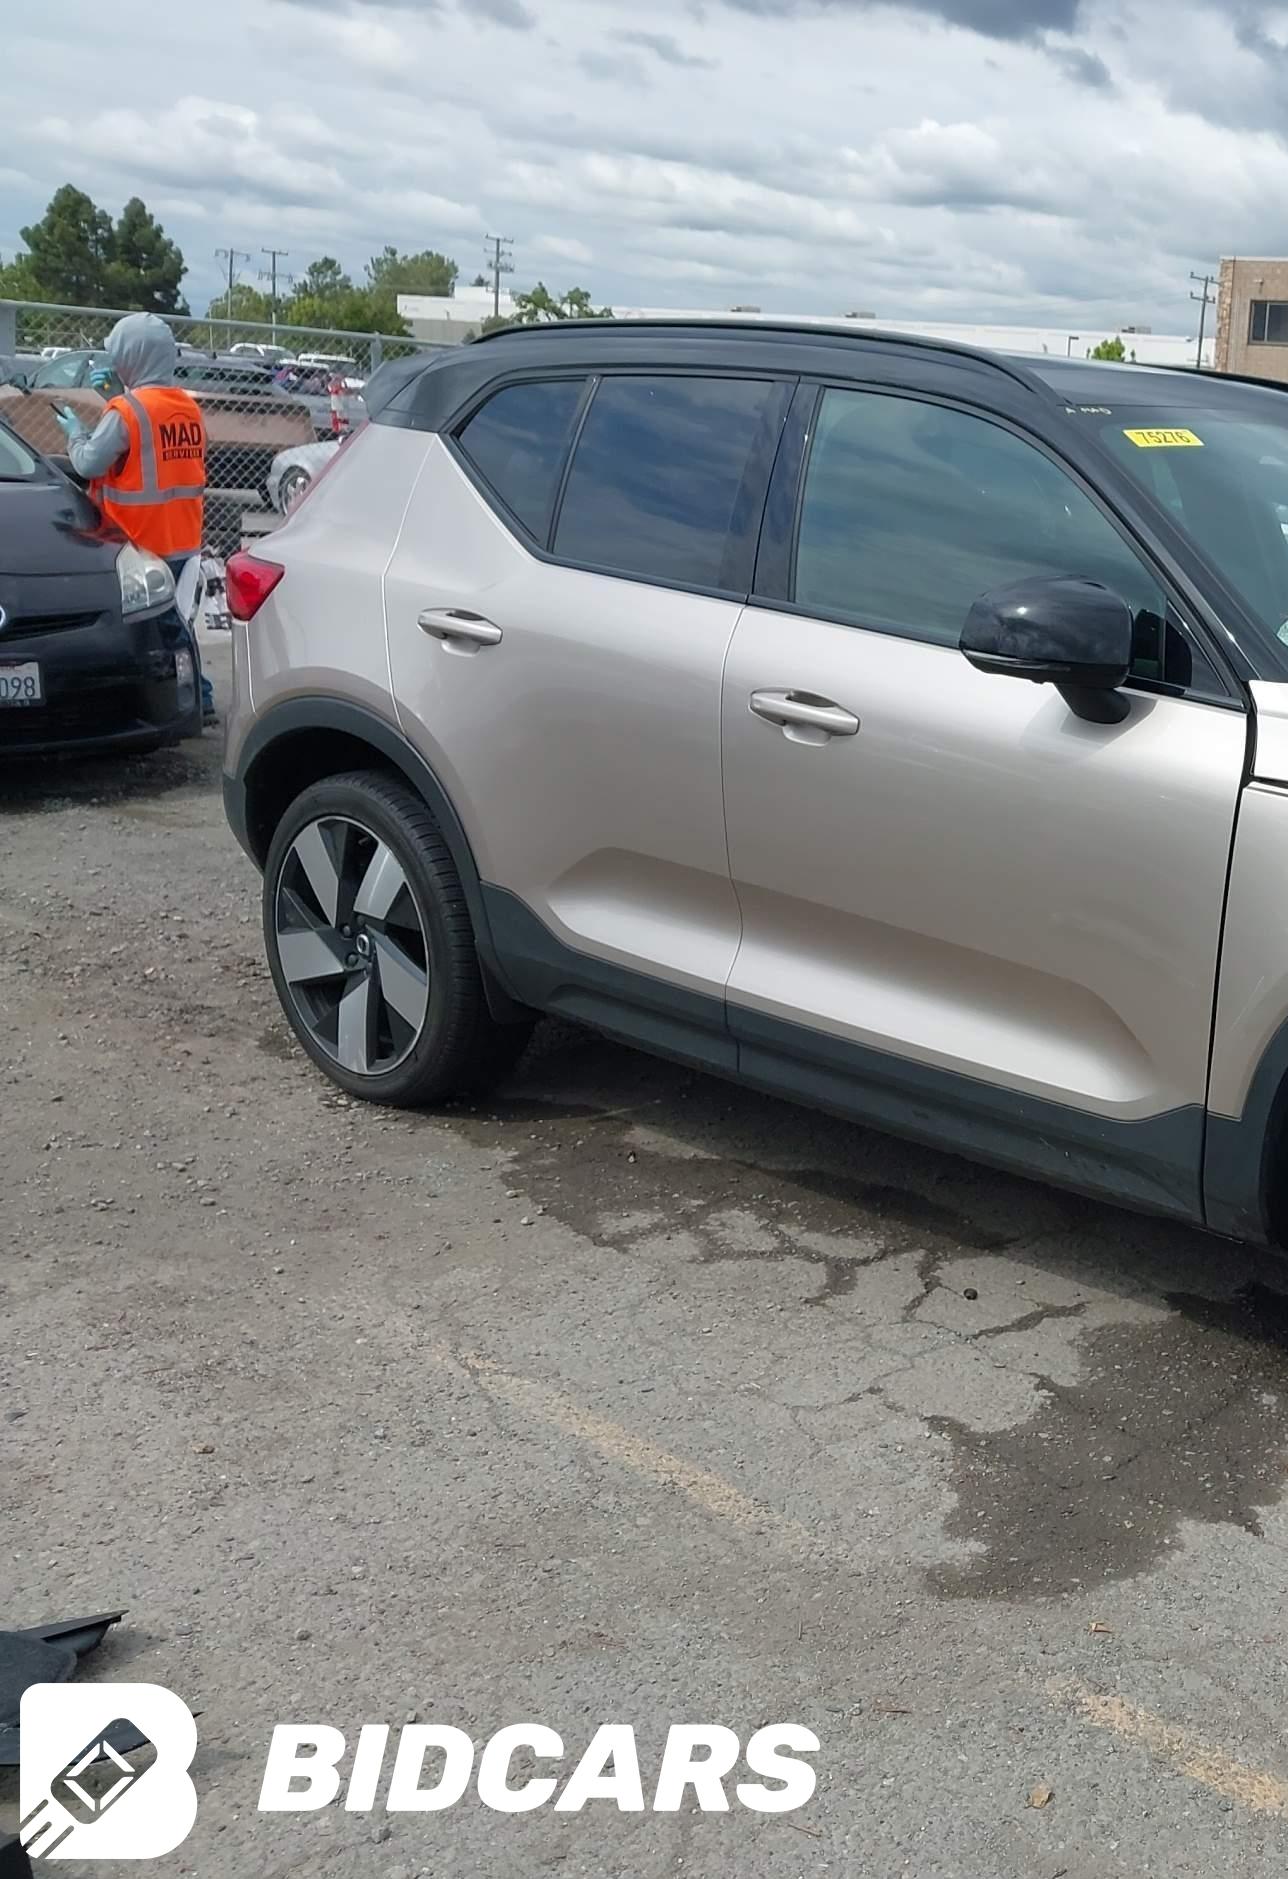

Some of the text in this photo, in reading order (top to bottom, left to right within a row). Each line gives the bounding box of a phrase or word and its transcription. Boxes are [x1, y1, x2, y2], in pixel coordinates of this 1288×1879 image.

[159, 422, 202, 448] MAD
[1135, 431, 1191, 444] 75276
[0, 676, 35, 699] 098
